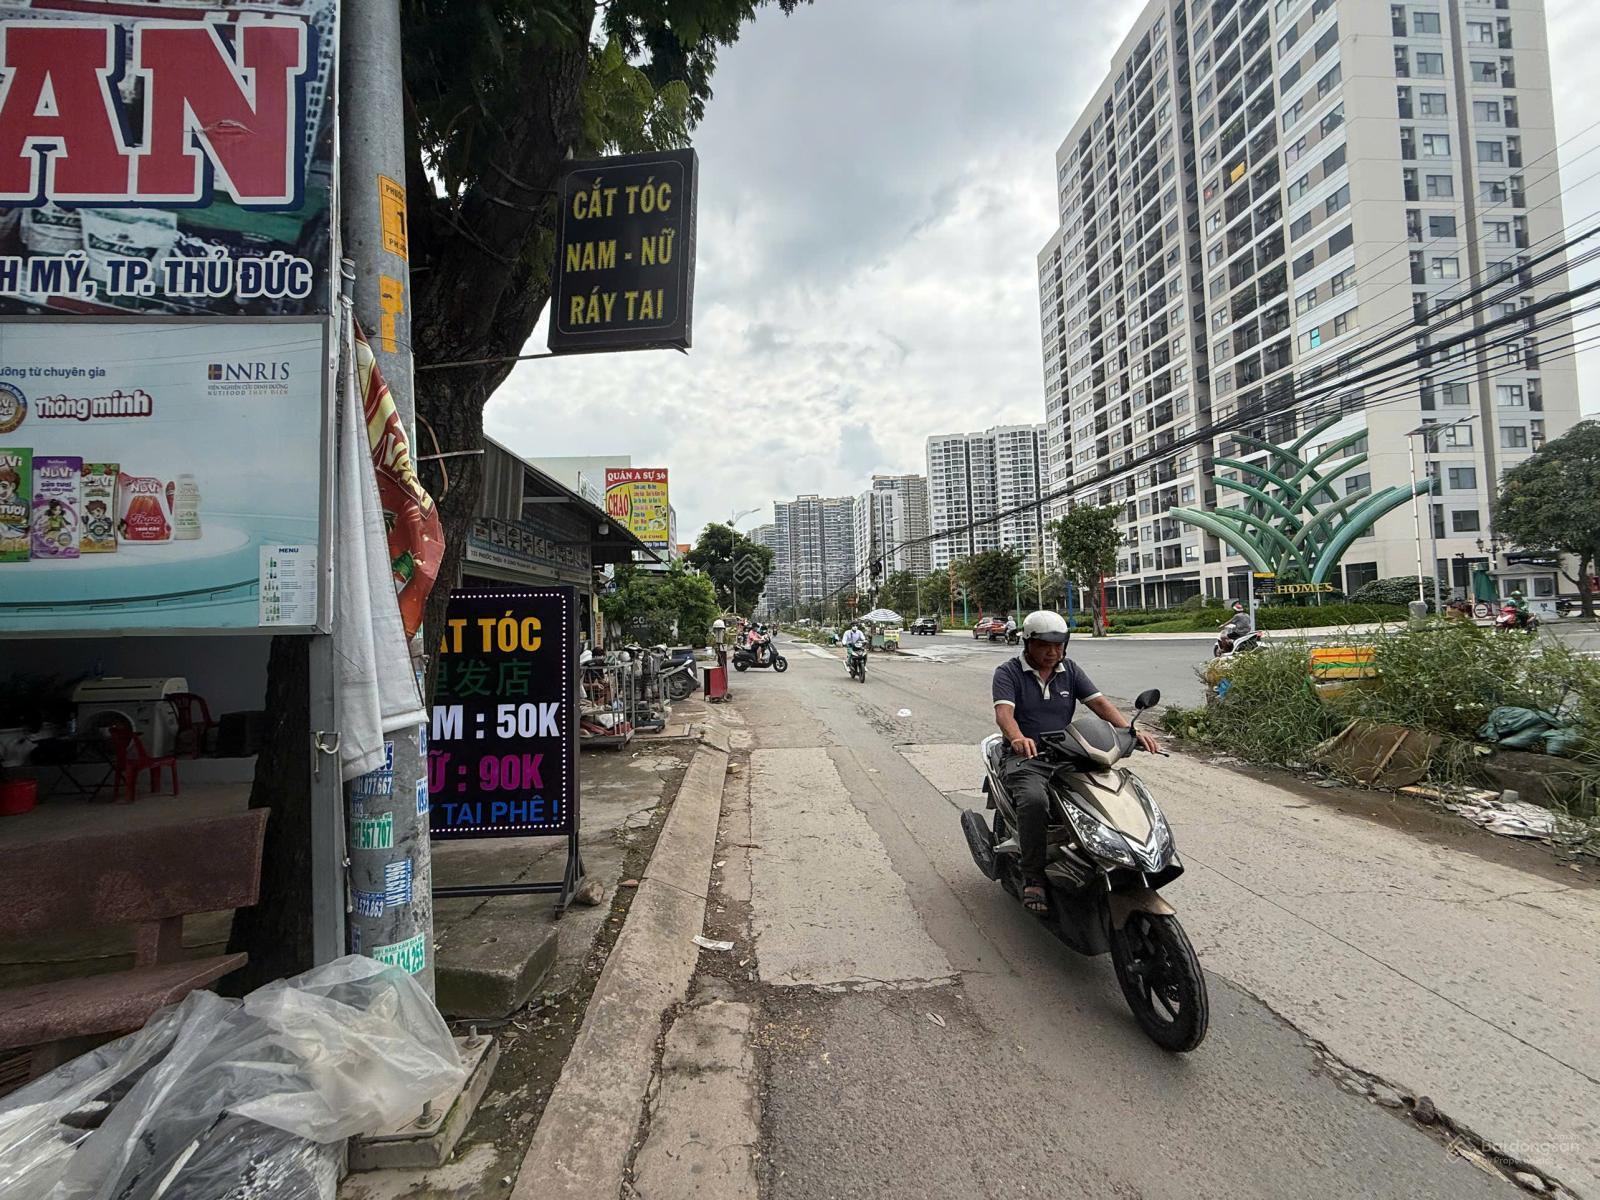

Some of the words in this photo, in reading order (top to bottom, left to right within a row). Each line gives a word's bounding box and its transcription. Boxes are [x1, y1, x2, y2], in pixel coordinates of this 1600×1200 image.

[573, 177, 618, 219] CẮT
[625, 176, 672, 214] TÓC
[566, 240, 617, 272] NAM
[624, 251, 632, 260] -
[641, 227, 676, 266] NỮ
[31, 252, 96, 298] MỸ,
[106, 259, 154, 296] TP.
[165, 248, 231, 296] THỦ
[239, 251, 311, 299] ĐỨC
[570, 286, 617, 325] RÁY
[624, 289, 664, 321] TAI
[29, 366, 42, 377] từ
[44, 366, 85, 379] chuyên
[88, 367, 106, 379] gia
[226, 362, 290, 381] NNRIS
[35, 394, 91, 421] Thông
[92, 389, 152, 417] minh
[608, 471, 632, 481] QUÁN
[656, 472, 666, 480] 36
[608, 488, 628, 517] CHÁO
[1277, 583, 1333, 594] HOMES
[478, 610, 541, 653] TÓC
[476, 713, 485, 739] :
[496, 702, 560, 739] 50K
[458, 765, 467, 792] :
[480, 753, 544, 791] 90K
[442, 802, 482, 825] TAI
[491, 795, 544, 823] PHÊ
[552, 799, 559, 821] !
